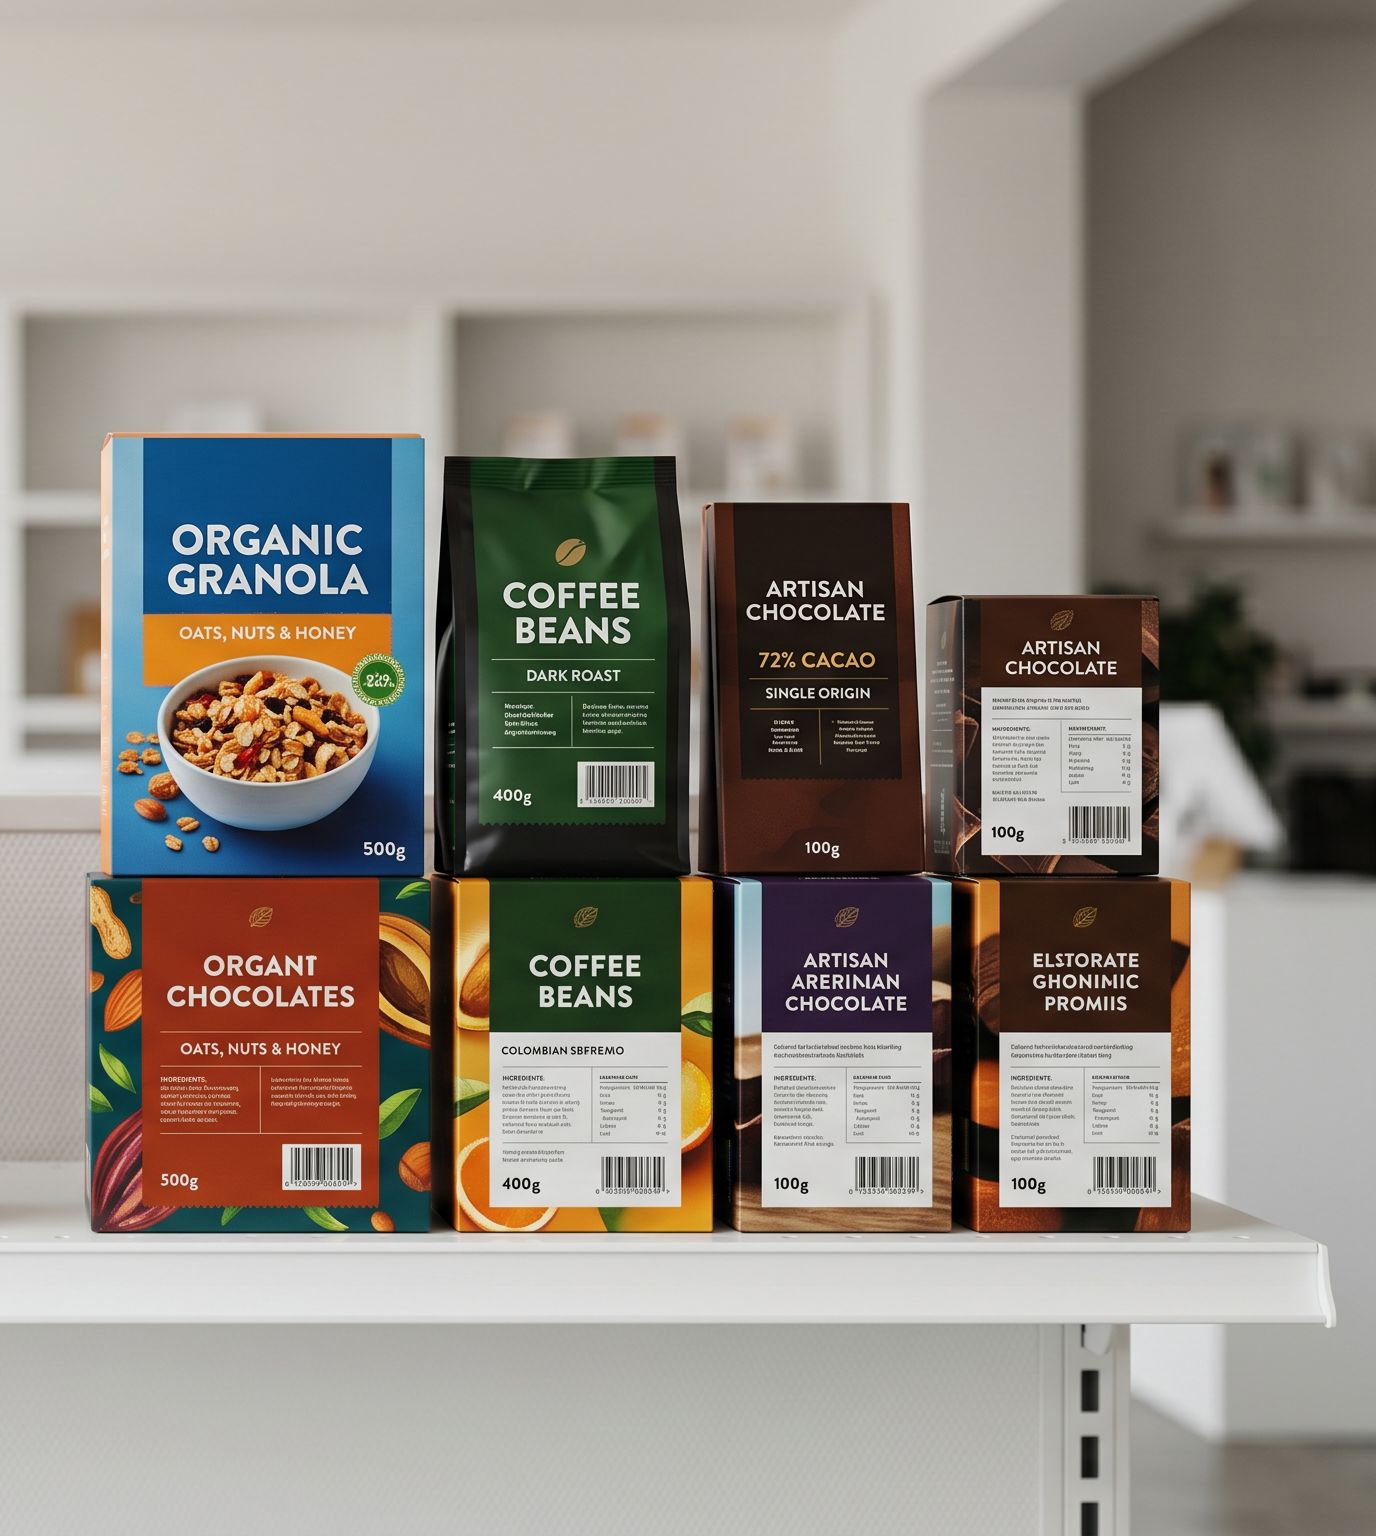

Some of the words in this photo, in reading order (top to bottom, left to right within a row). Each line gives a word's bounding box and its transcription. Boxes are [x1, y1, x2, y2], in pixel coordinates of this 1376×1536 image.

[172, 524, 362, 555] ORGANIC
[168, 564, 368, 595] GRANOLA
[503, 582, 639, 609] COFFEE
[766, 581, 863, 597] ARTISAN
[746, 604, 885, 620] CHOCOLATE
[179, 626, 226, 642] OATS,
[232, 626, 275, 640] NUTS
[280, 626, 291, 639] &
[296, 626, 356, 639] HONEY
[516, 617, 630, 644] BEANS
[1022, 641, 1099, 655] ARTISAN
[759, 652, 796, 668] 72%
[802, 652, 875, 668] CACAO
[1006, 661, 1117, 675] CHOCOLATE
[527, 670, 567, 681] DARK
[572, 670, 621, 681] ROAST
[766, 688, 815, 699] SINGLE
[819, 688, 870, 699] ORIGIN
[493, 789, 531, 806] 400g
[992, 827, 1024, 842] 100g
[364, 842, 405, 861] 500g
[805, 842, 840, 858] 100g
[204, 955, 317, 976] ORGANT
[529, 955, 640, 977] COFFEE
[804, 953, 887, 968] ARTISAN
[1034, 953, 1139, 967] ELSTORATE
[167, 986, 354, 1007] CHOCOLATES
[540, 986, 632, 1007] BEANS
[786, 996, 906, 1011] CHOCOLATE
[1046, 996, 1127, 1011] PROMIIS
[181, 1043, 223, 1057] OATS,
[229, 1043, 267, 1055] NUTS
[272, 1043, 281, 1055] &
[287, 1043, 340, 1055] HONEY
[502, 1047, 567, 1055] COLOMBIAN
[161, 1174, 198, 1190] 500g
[503, 1178, 540, 1194] 400g
[775, 1178, 808, 1194] 100g
[1012, 1178, 1046, 1194] 100g
